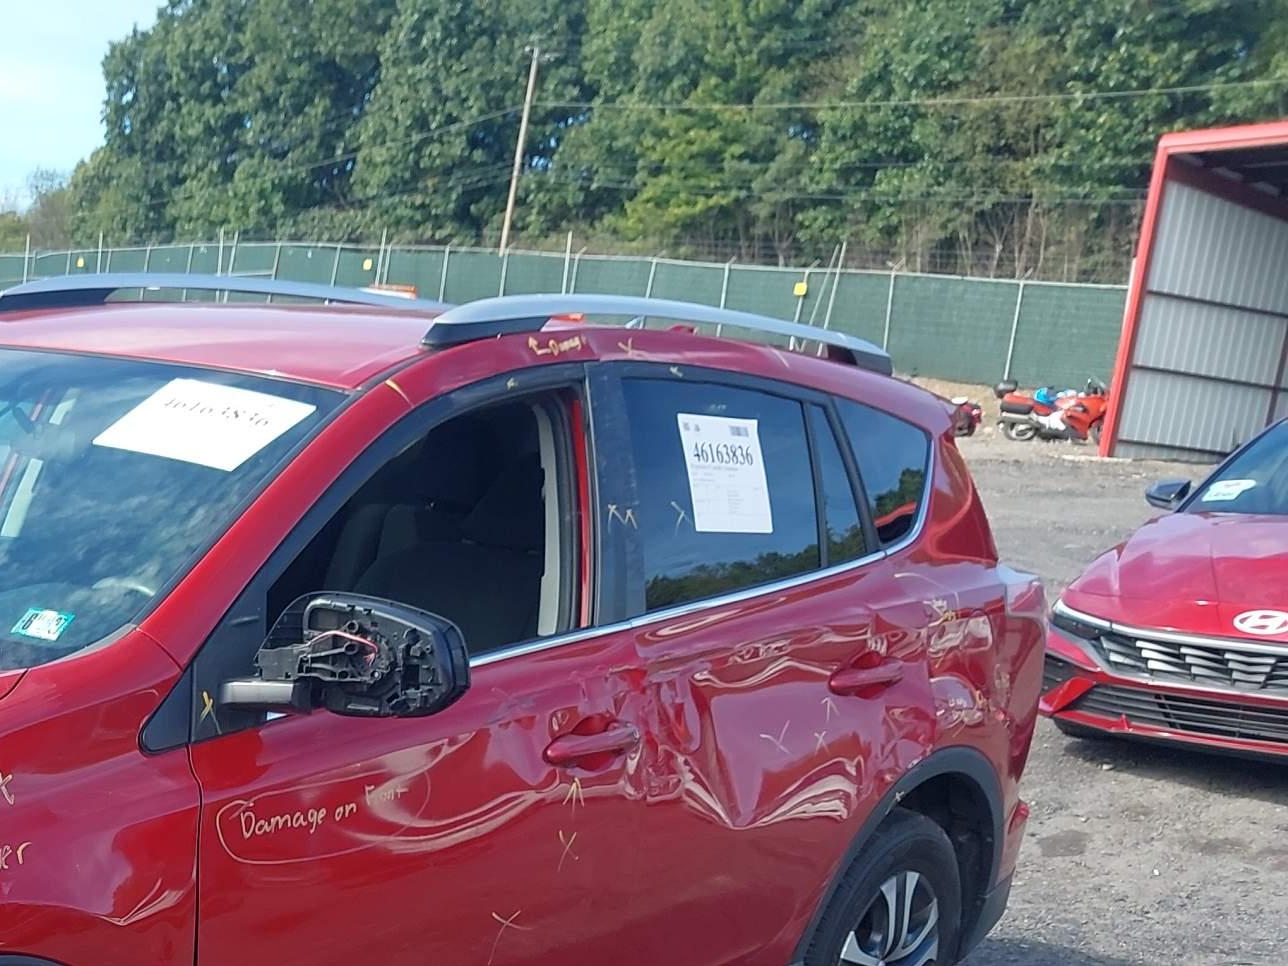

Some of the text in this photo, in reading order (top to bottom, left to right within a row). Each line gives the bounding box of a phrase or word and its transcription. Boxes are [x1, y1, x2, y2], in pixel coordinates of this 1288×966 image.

[694, 440, 754, 466] 46163836
[240, 807, 327, 839] Damage
[335, 802, 357, 821] on
